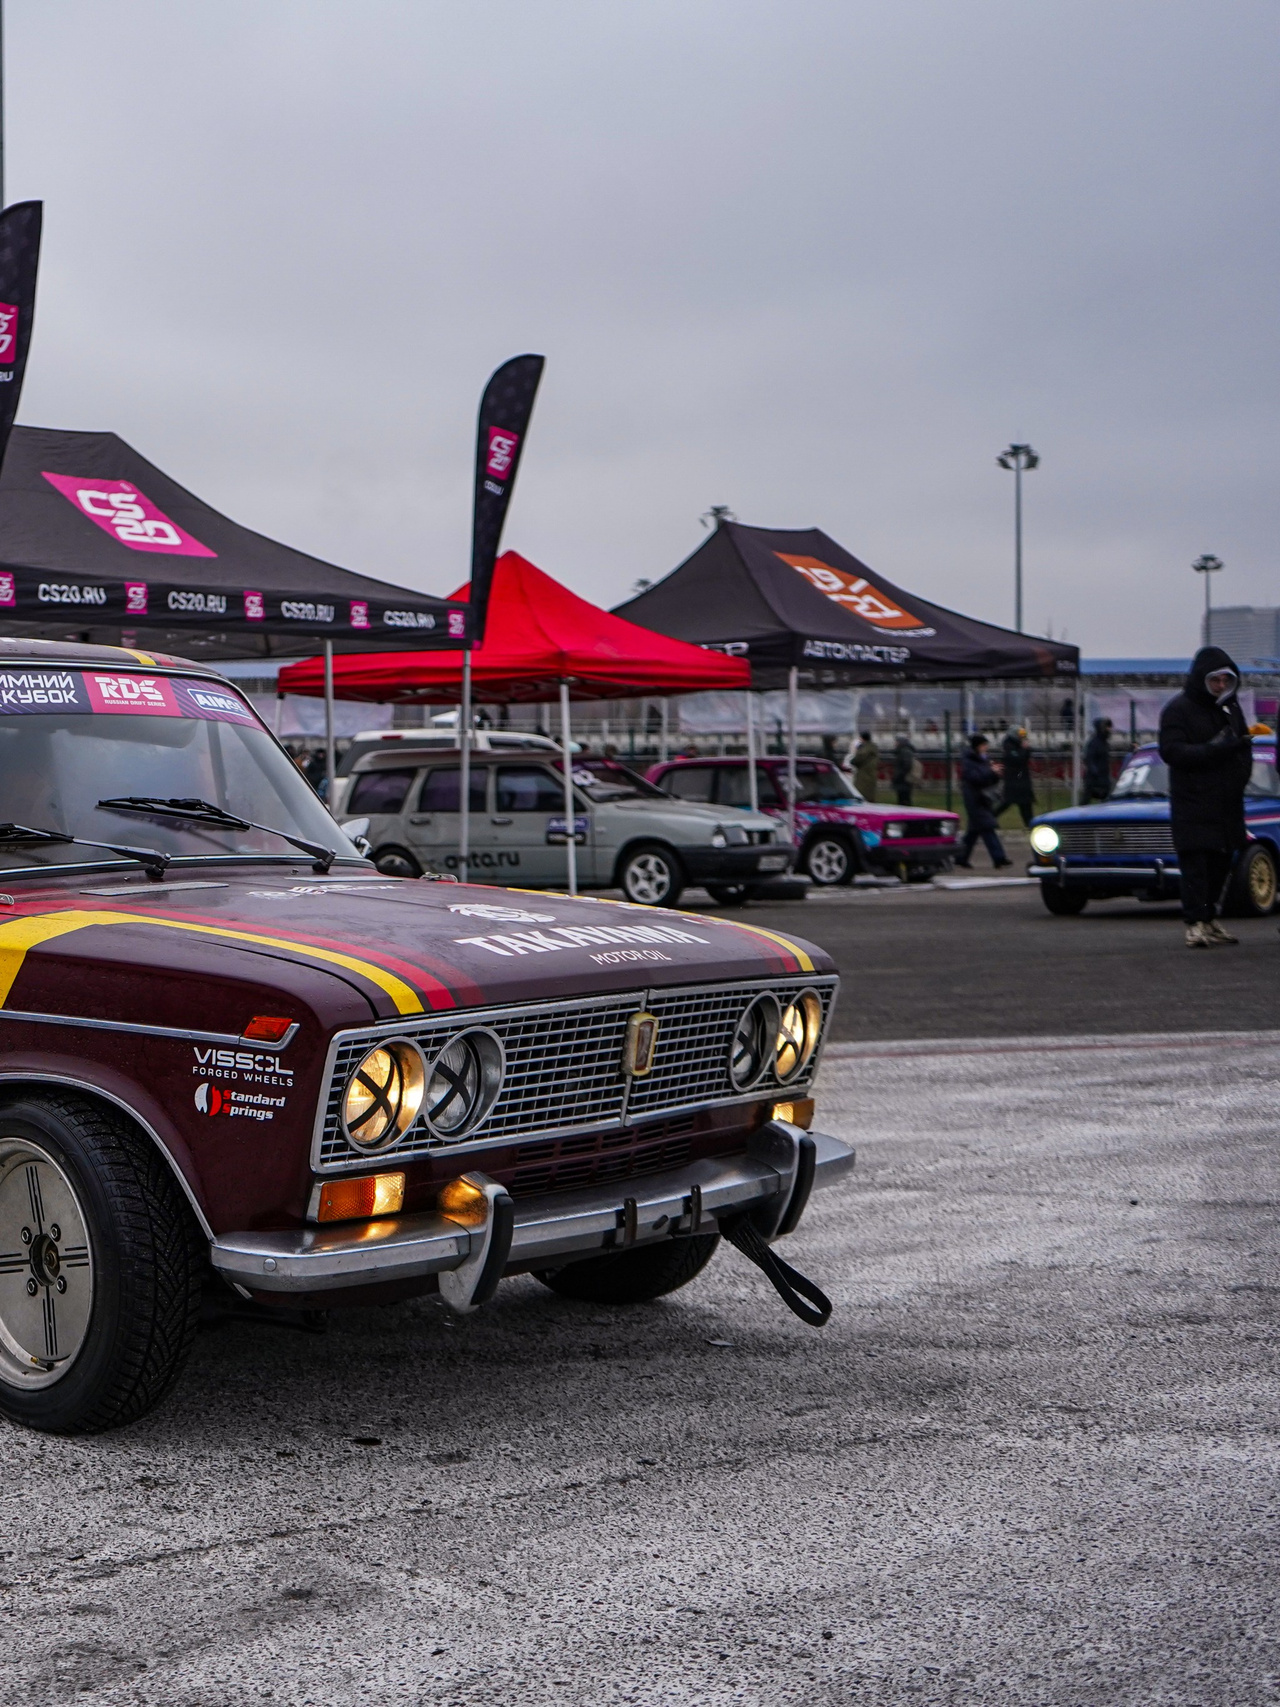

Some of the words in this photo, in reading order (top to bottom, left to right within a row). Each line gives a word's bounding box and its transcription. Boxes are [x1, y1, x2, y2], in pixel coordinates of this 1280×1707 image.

[38, 583, 107, 604] CS20.RU
[168, 591, 226, 613] CS20.RU
[281, 601, 334, 622] CS20.RU
[384, 610, 436, 629] CS20.RU
[2, 689, 78, 704] КУБОК
[94, 676, 164, 701] RDS
[453, 925, 710, 957] TAKAYAMA
[590, 950, 648, 966] MOTOR
[646, 949, 672, 961] OIL
[193, 1047, 294, 1075] VISSOL
[192, 1066, 238, 1080] FORGED
[243, 1072, 294, 1087] WHEELS
[223, 1089, 286, 1108] Standard
[222, 1103, 274, 1121] Springs
